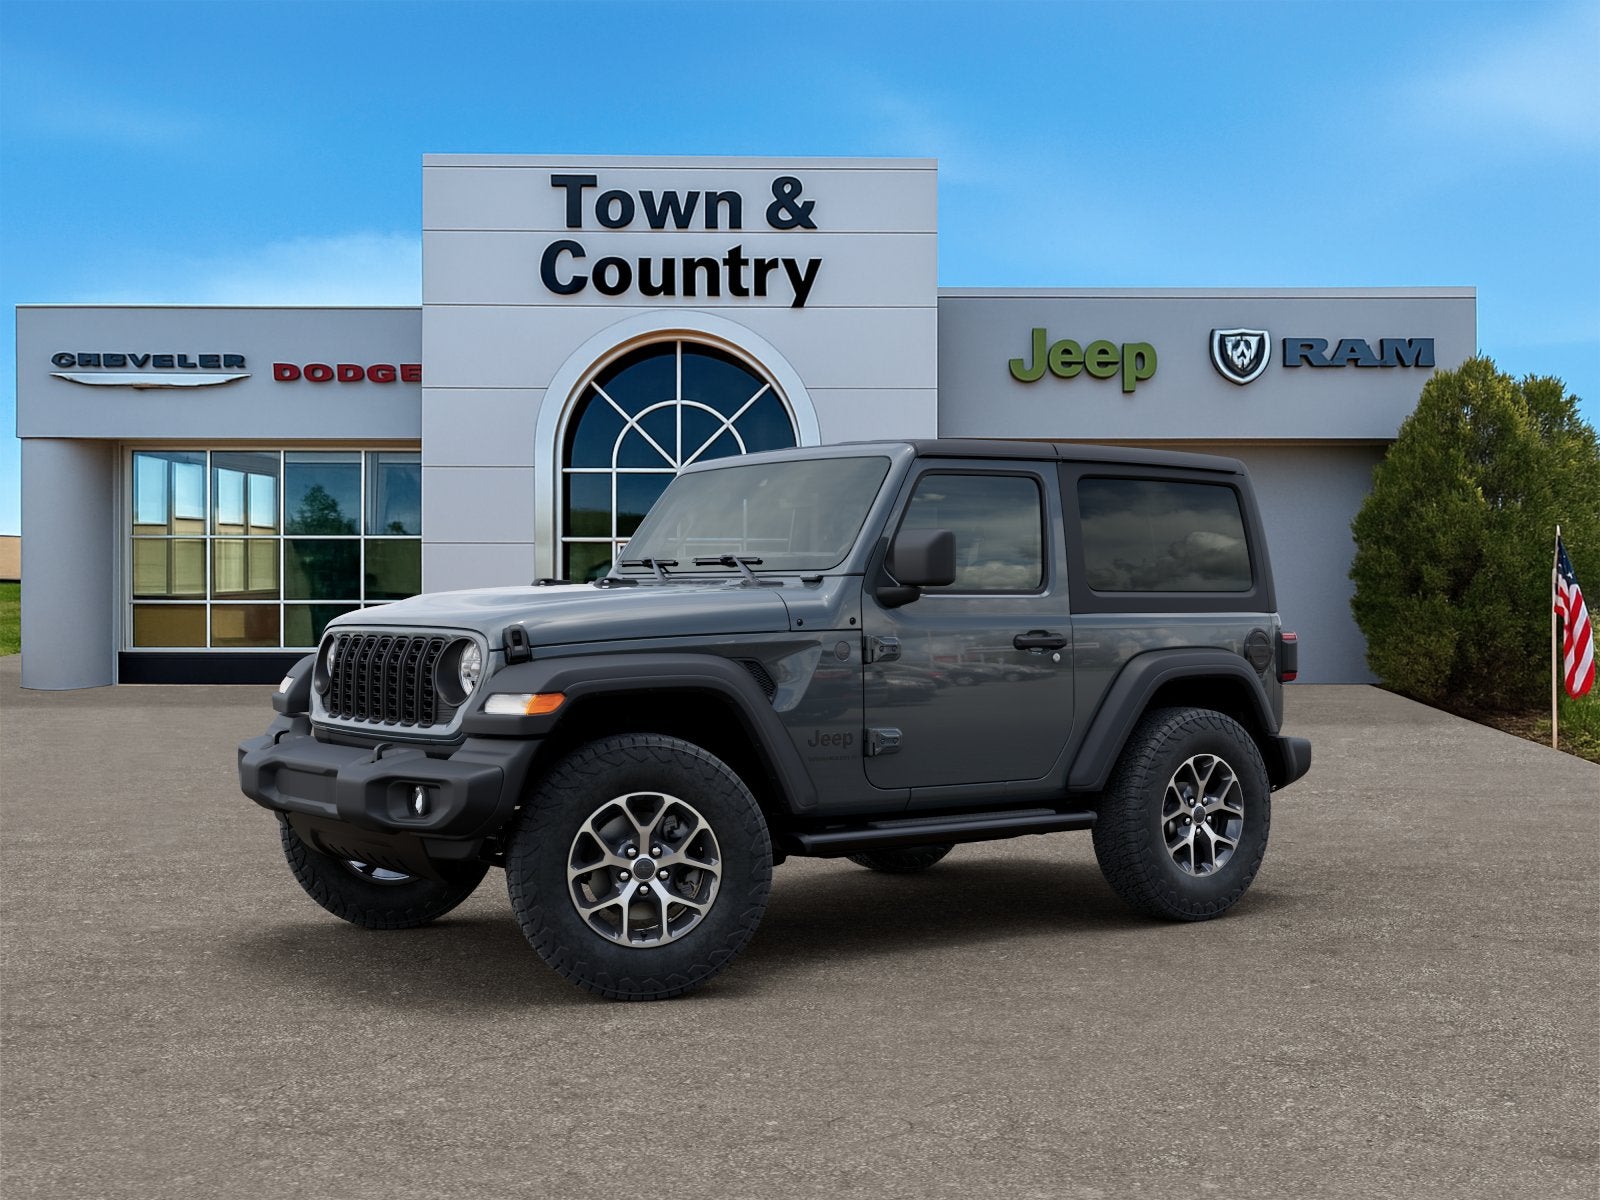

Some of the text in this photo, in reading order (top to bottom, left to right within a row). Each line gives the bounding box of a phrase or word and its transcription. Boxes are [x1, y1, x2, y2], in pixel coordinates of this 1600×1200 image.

[550, 174, 818, 230] Town &
[540, 239, 822, 308] Country
[273, 362, 422, 383] DODGE
[1009, 328, 1158, 392] Jeep
[1282, 337, 1436, 368] RAM
[808, 730, 853, 749] Jeep
